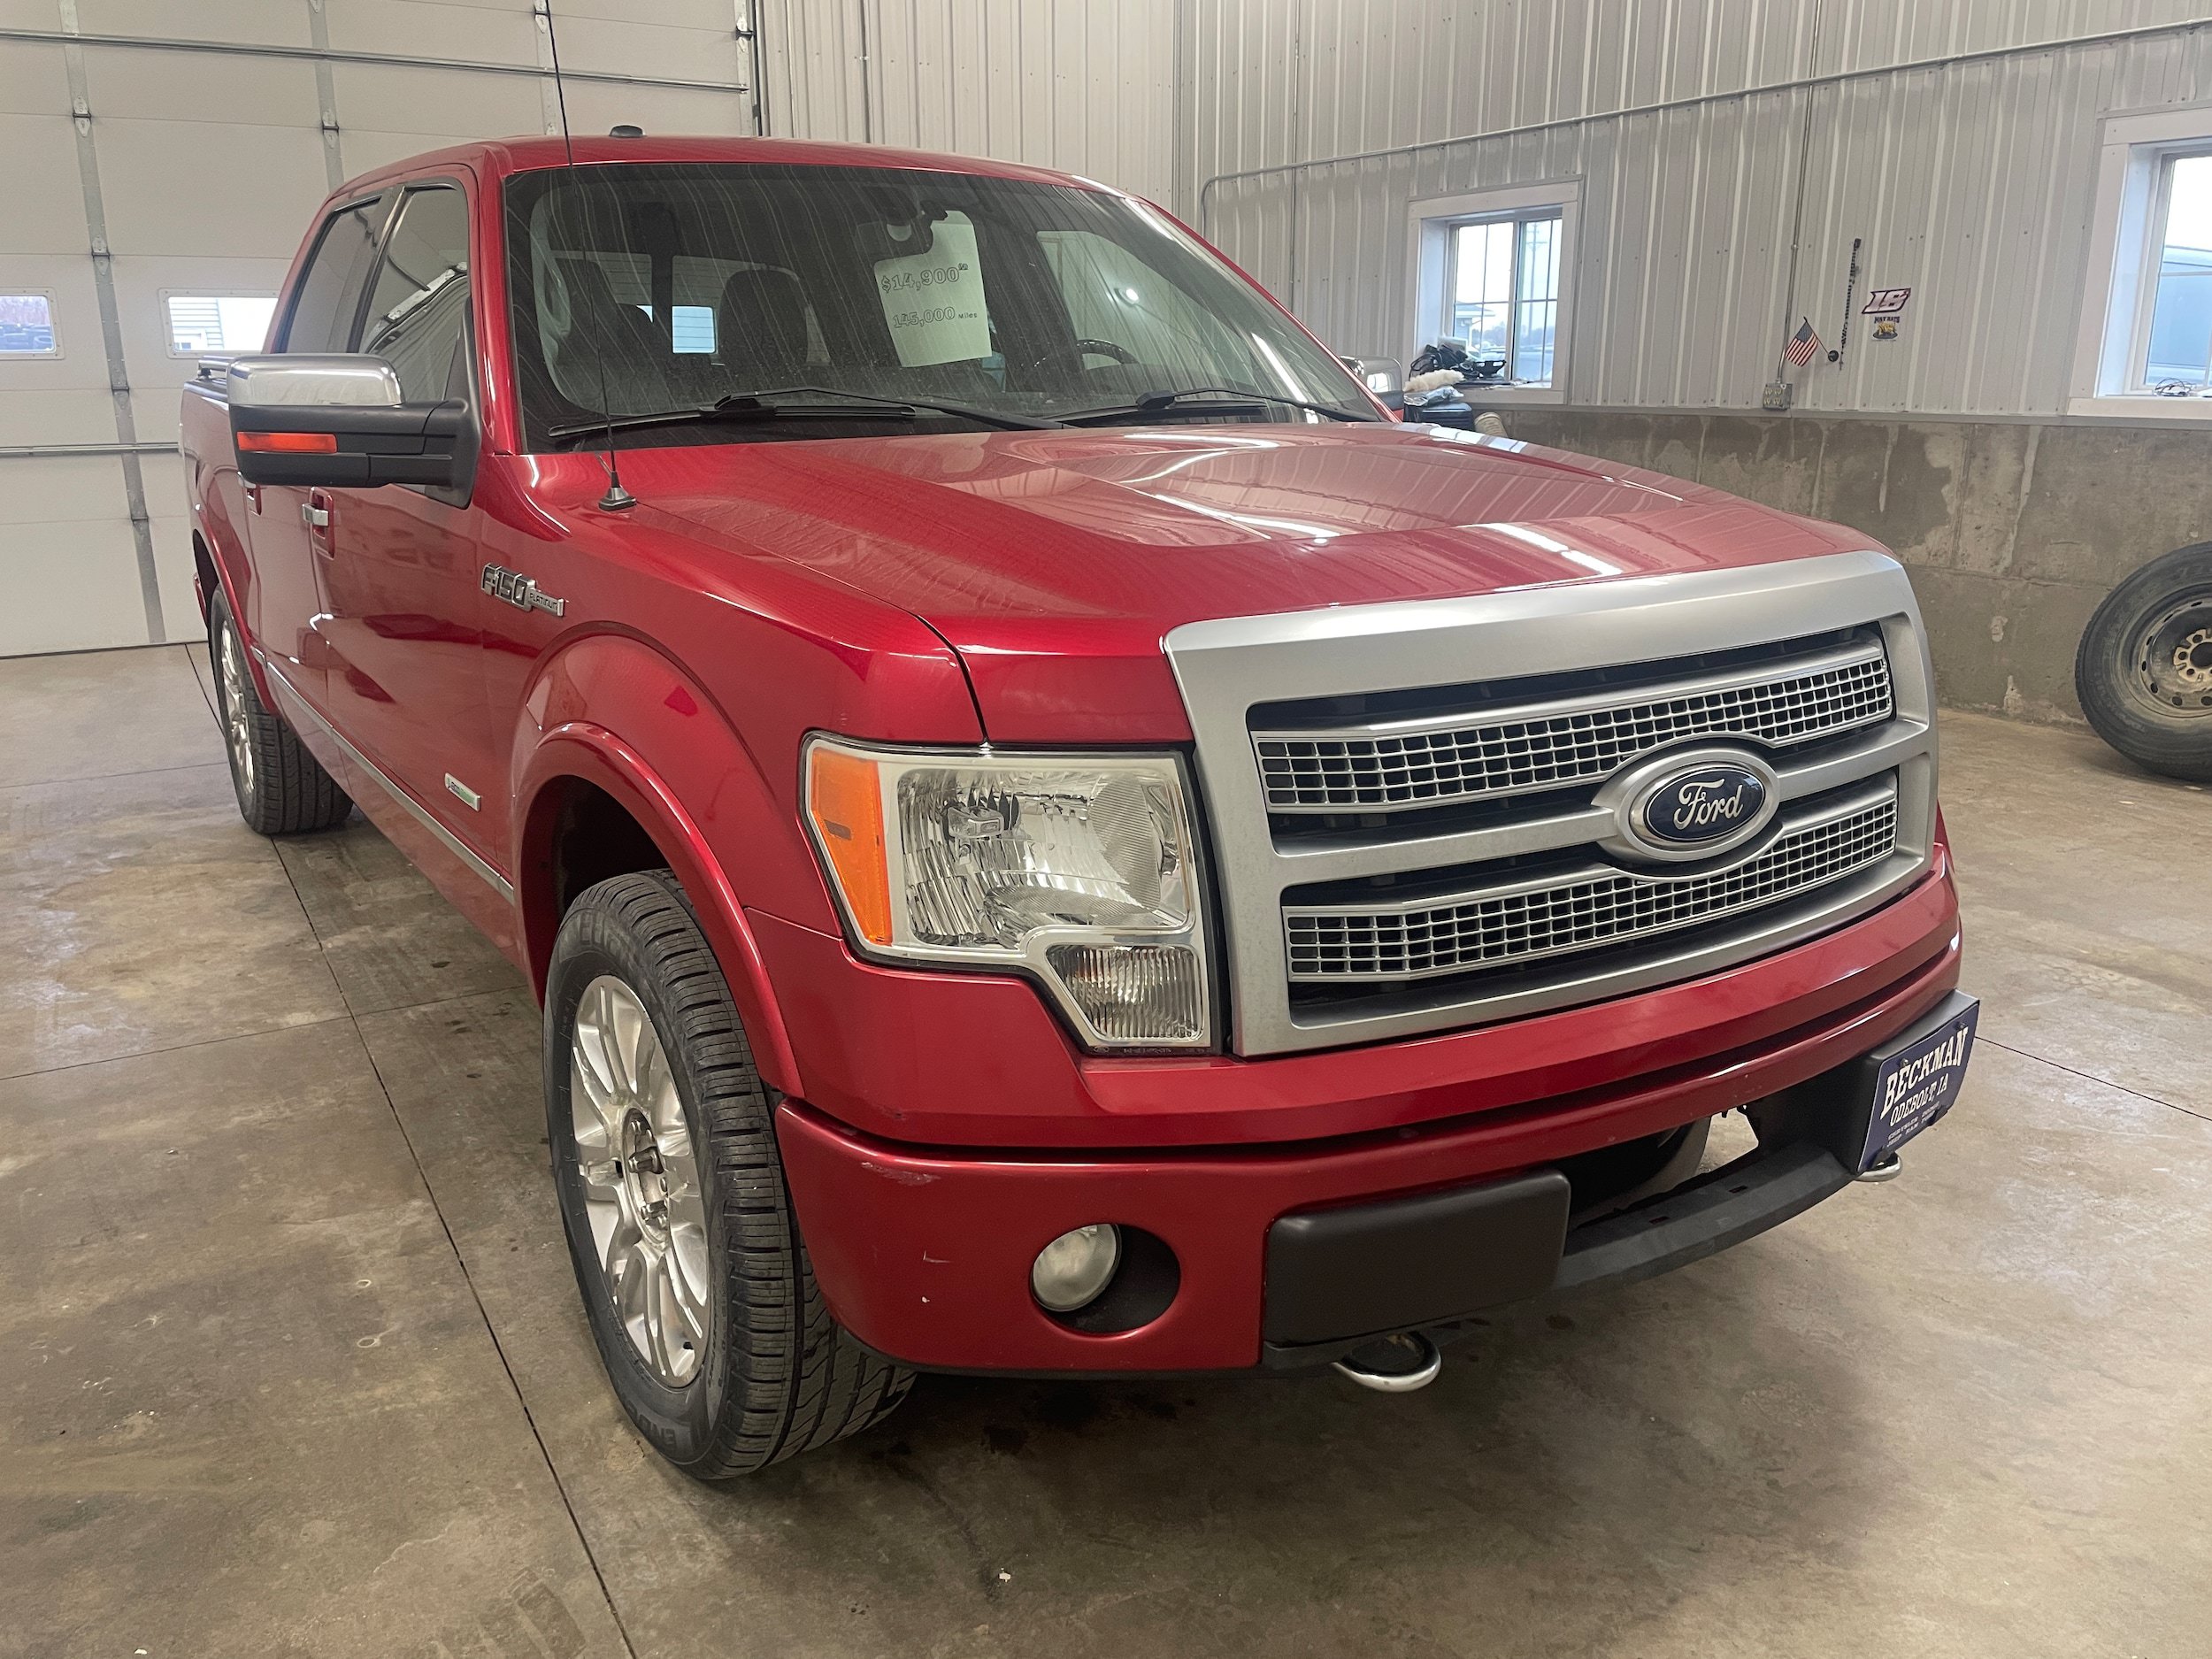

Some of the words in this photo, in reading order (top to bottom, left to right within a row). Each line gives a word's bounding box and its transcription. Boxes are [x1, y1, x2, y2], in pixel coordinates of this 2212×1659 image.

[881, 266, 959, 293] $14,900
[893, 306, 956, 328] 145,000
[1673, 778, 1744, 830] Ford
[1880, 1026, 1969, 1119] BECKMAN
[1938, 1073, 1949, 1095] IA
